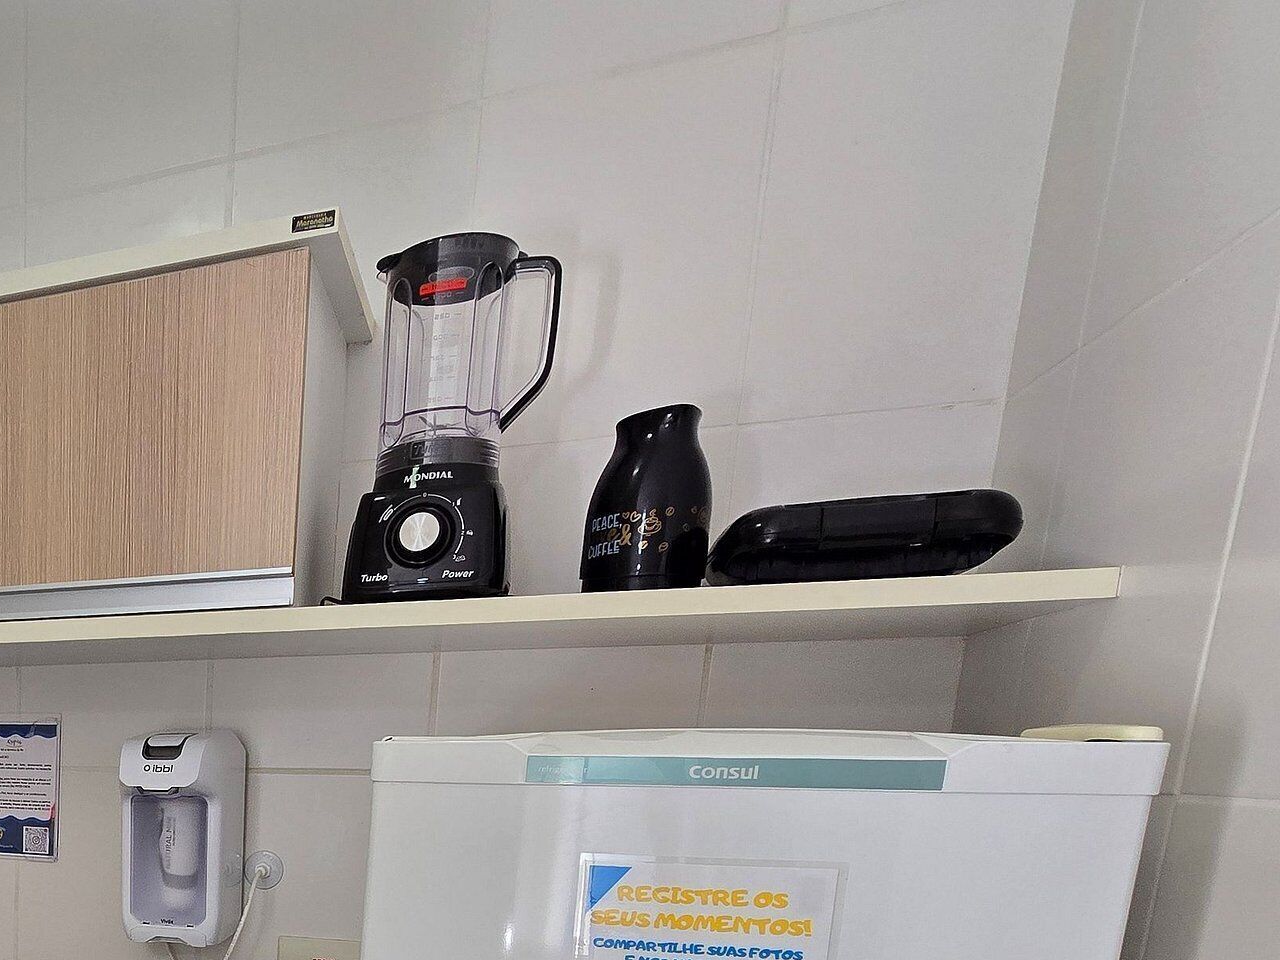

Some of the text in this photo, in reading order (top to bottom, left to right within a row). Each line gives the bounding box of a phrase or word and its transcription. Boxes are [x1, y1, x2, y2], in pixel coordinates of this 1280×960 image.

[403, 470, 454, 483] MONDIAL
[360, 569, 475, 583] Turbo Power
[688, 764, 760, 780] Consul
[617, 885, 789, 909] REGISTRE OS
[590, 909, 813, 937] SEUS MOMENTOS!
[593, 937, 804, 960] COMPARTILHE SUAS FOTOS
